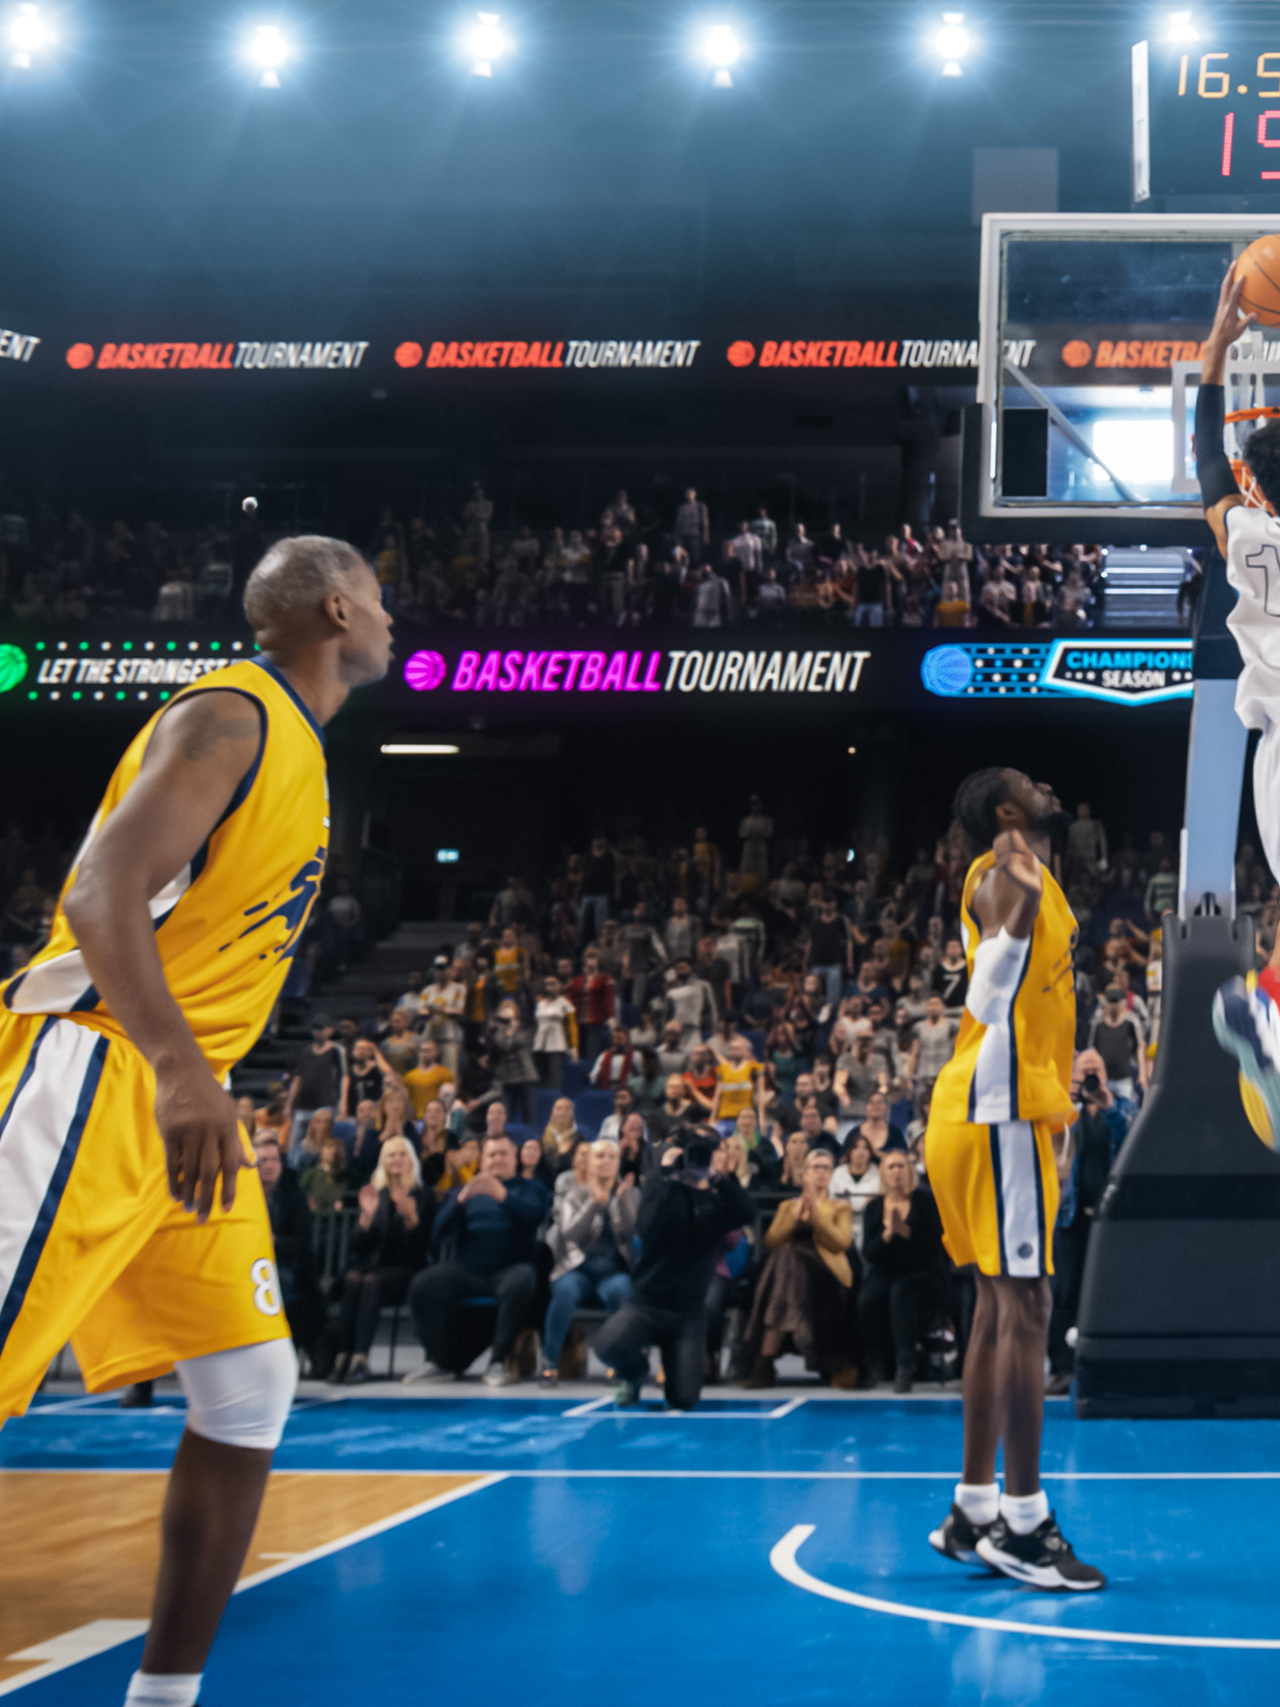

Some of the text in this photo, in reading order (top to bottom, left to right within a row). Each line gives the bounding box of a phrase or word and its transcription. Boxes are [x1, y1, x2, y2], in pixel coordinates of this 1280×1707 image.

[96, 341, 370, 369] BASKETBALL TOURNAMENT
[425, 340, 700, 368] BASKETBALL TOURNAMENT
[758, 340, 898, 368] BASKETBALL
[37, 658, 77, 683] LET
[76, 658, 116, 683] THE
[451, 650, 872, 692] BASKETBALL TOURNAMENT
[1101, 670, 1166, 688] SEASON
[250, 1257, 283, 1317] 8
